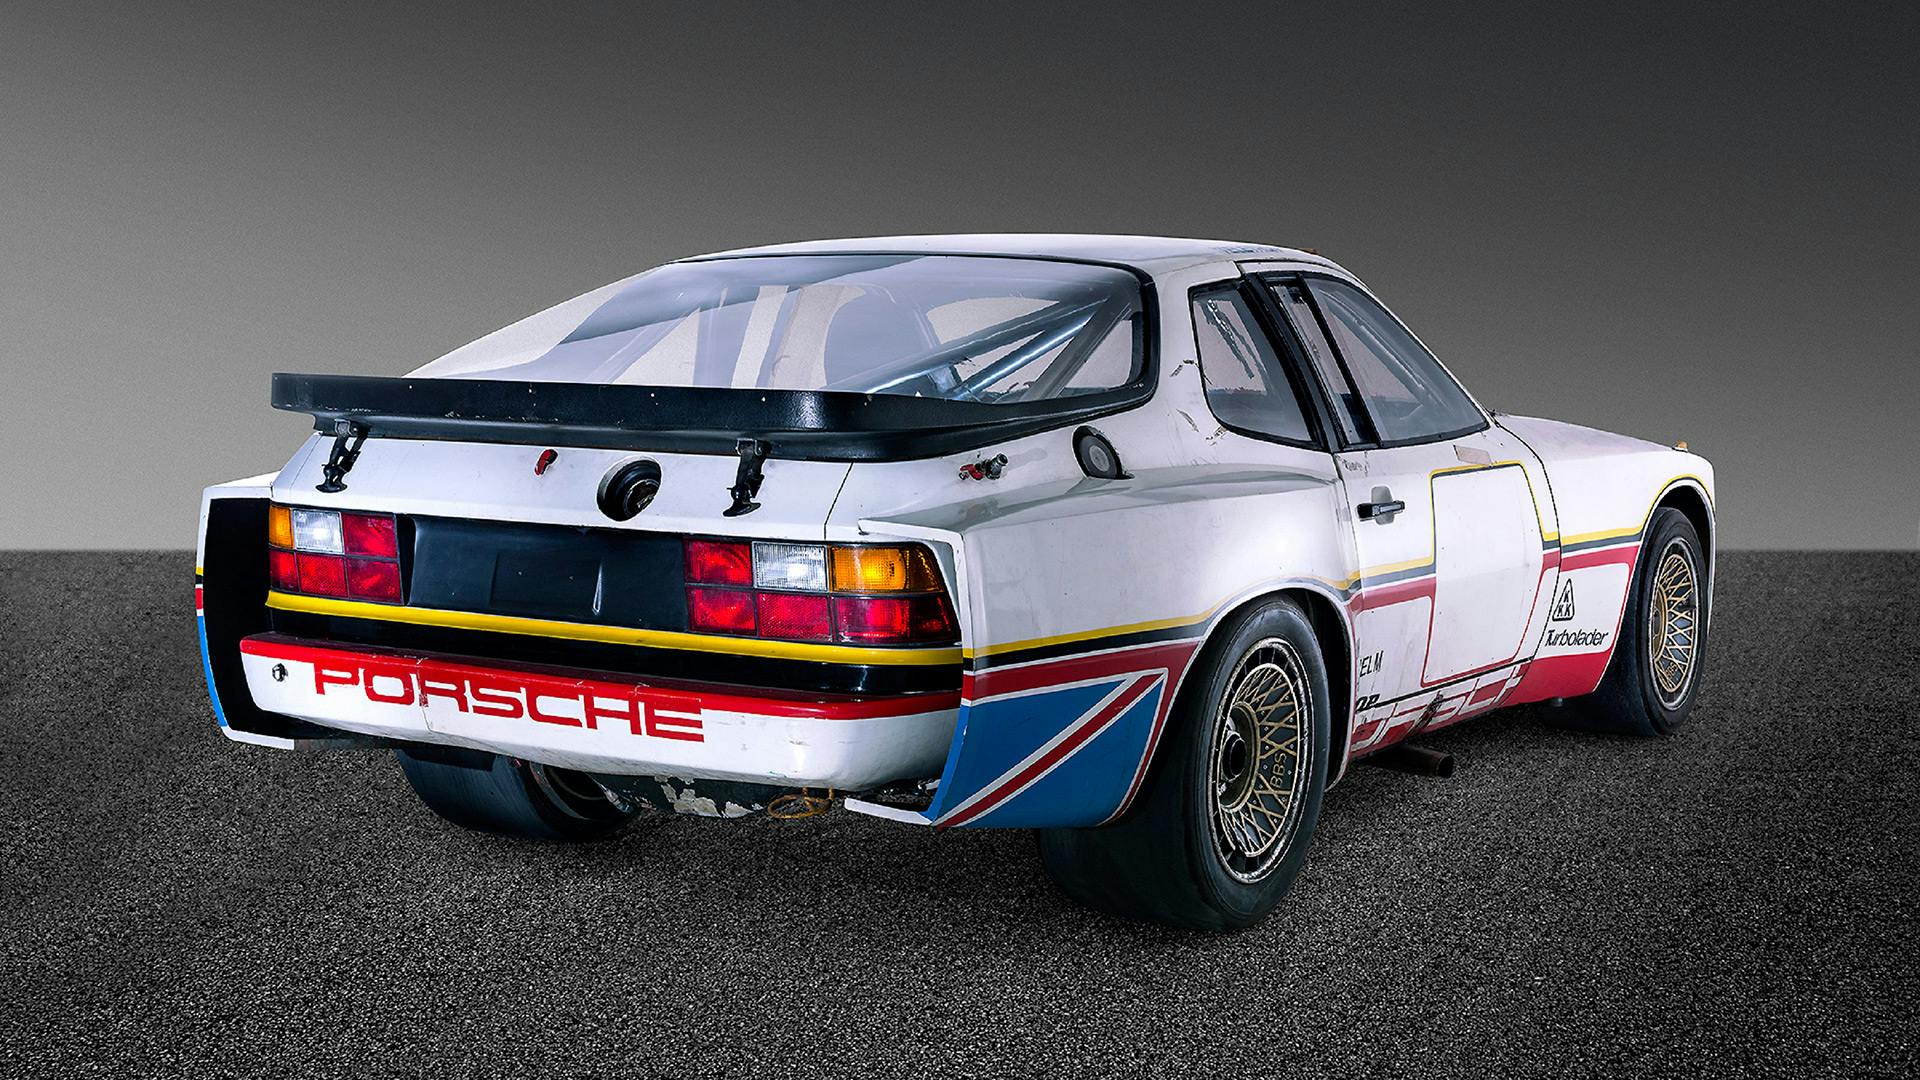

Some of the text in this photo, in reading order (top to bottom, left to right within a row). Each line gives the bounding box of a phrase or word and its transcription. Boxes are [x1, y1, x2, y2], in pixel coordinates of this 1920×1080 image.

[1545, 628, 1609, 647] Turbolader
[1359, 650, 1384, 678] ELM
[314, 660, 704, 742] PORSCHE
[1270, 753, 1287, 788] BBS
